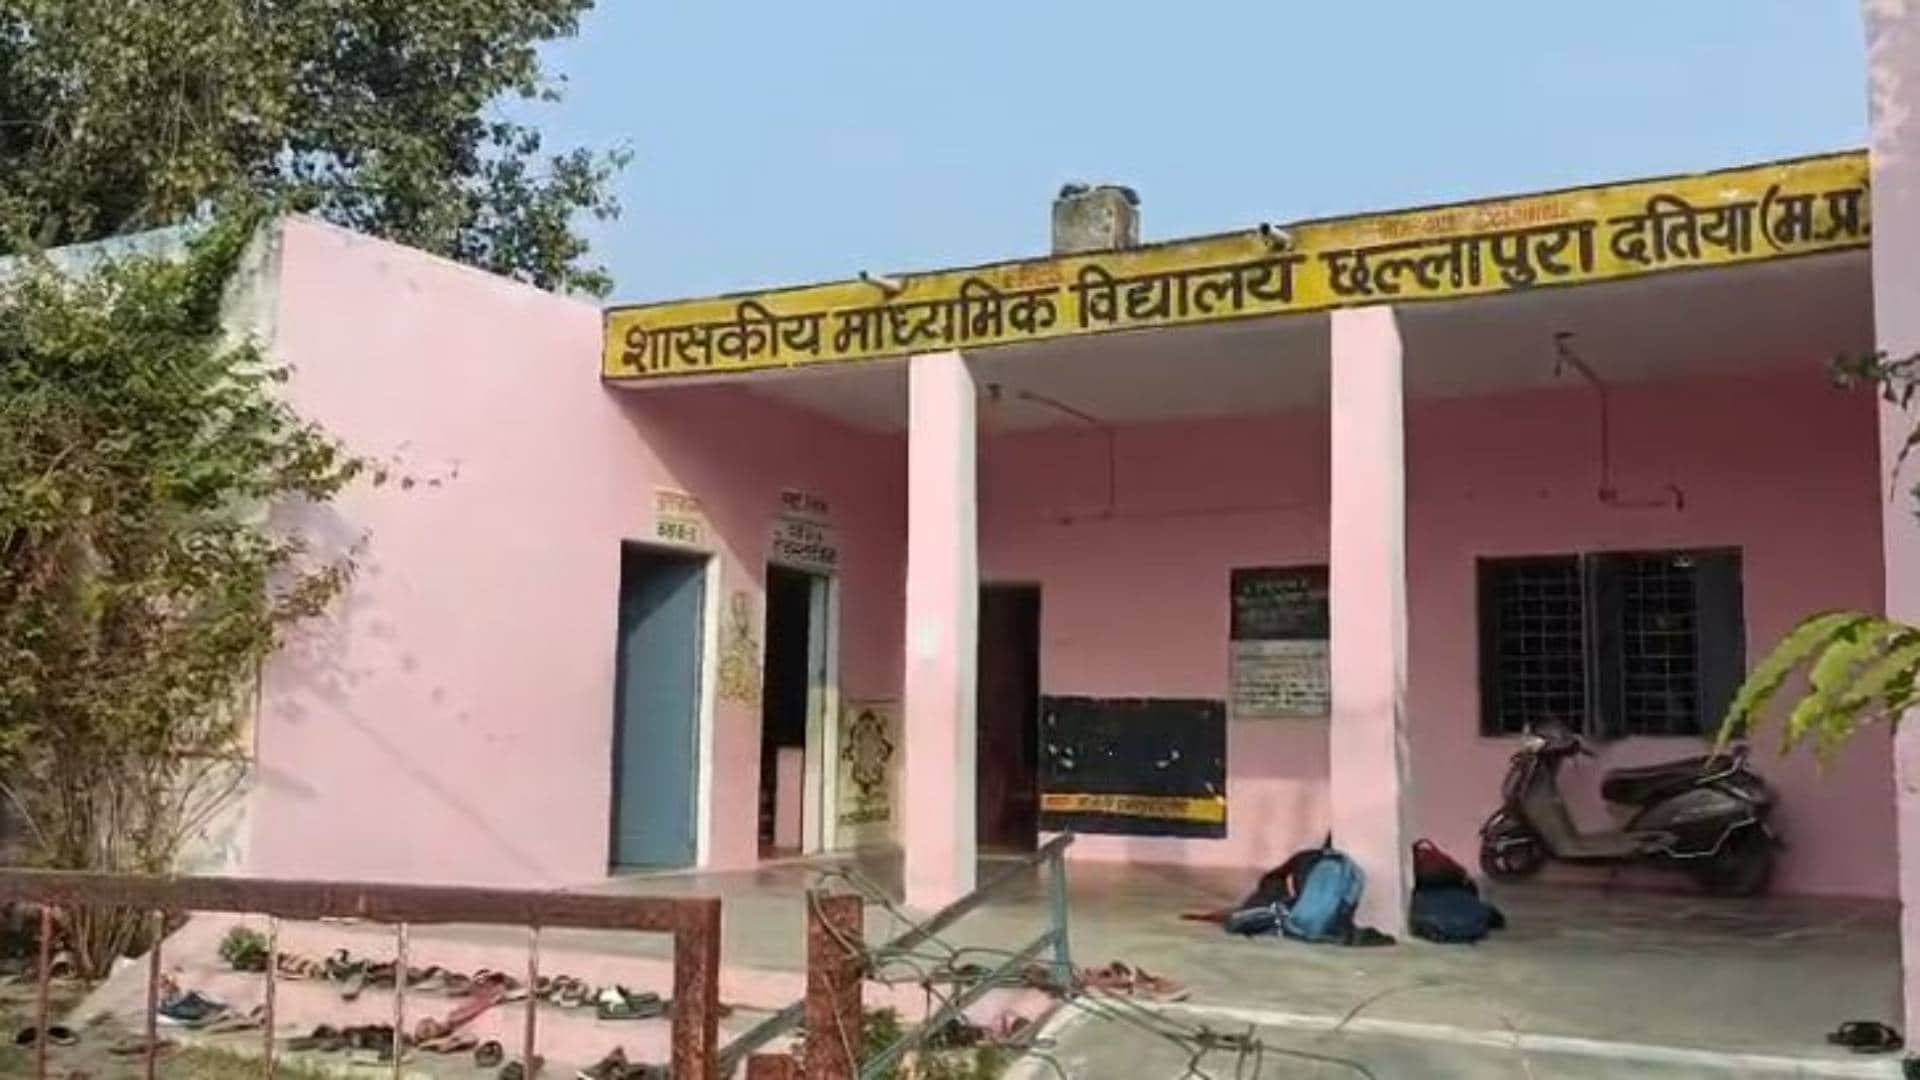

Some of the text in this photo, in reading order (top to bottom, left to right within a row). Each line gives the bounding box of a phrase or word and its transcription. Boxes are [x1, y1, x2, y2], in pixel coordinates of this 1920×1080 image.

[622, 300, 828, 372] शासकीय
[832, 277, 1061, 352] माध्यमिक
[1068, 253, 1307, 328] विद्यालय
[1319, 219, 1598, 296] छल्लापुरा
[1607, 193, 1759, 264] दतिया
